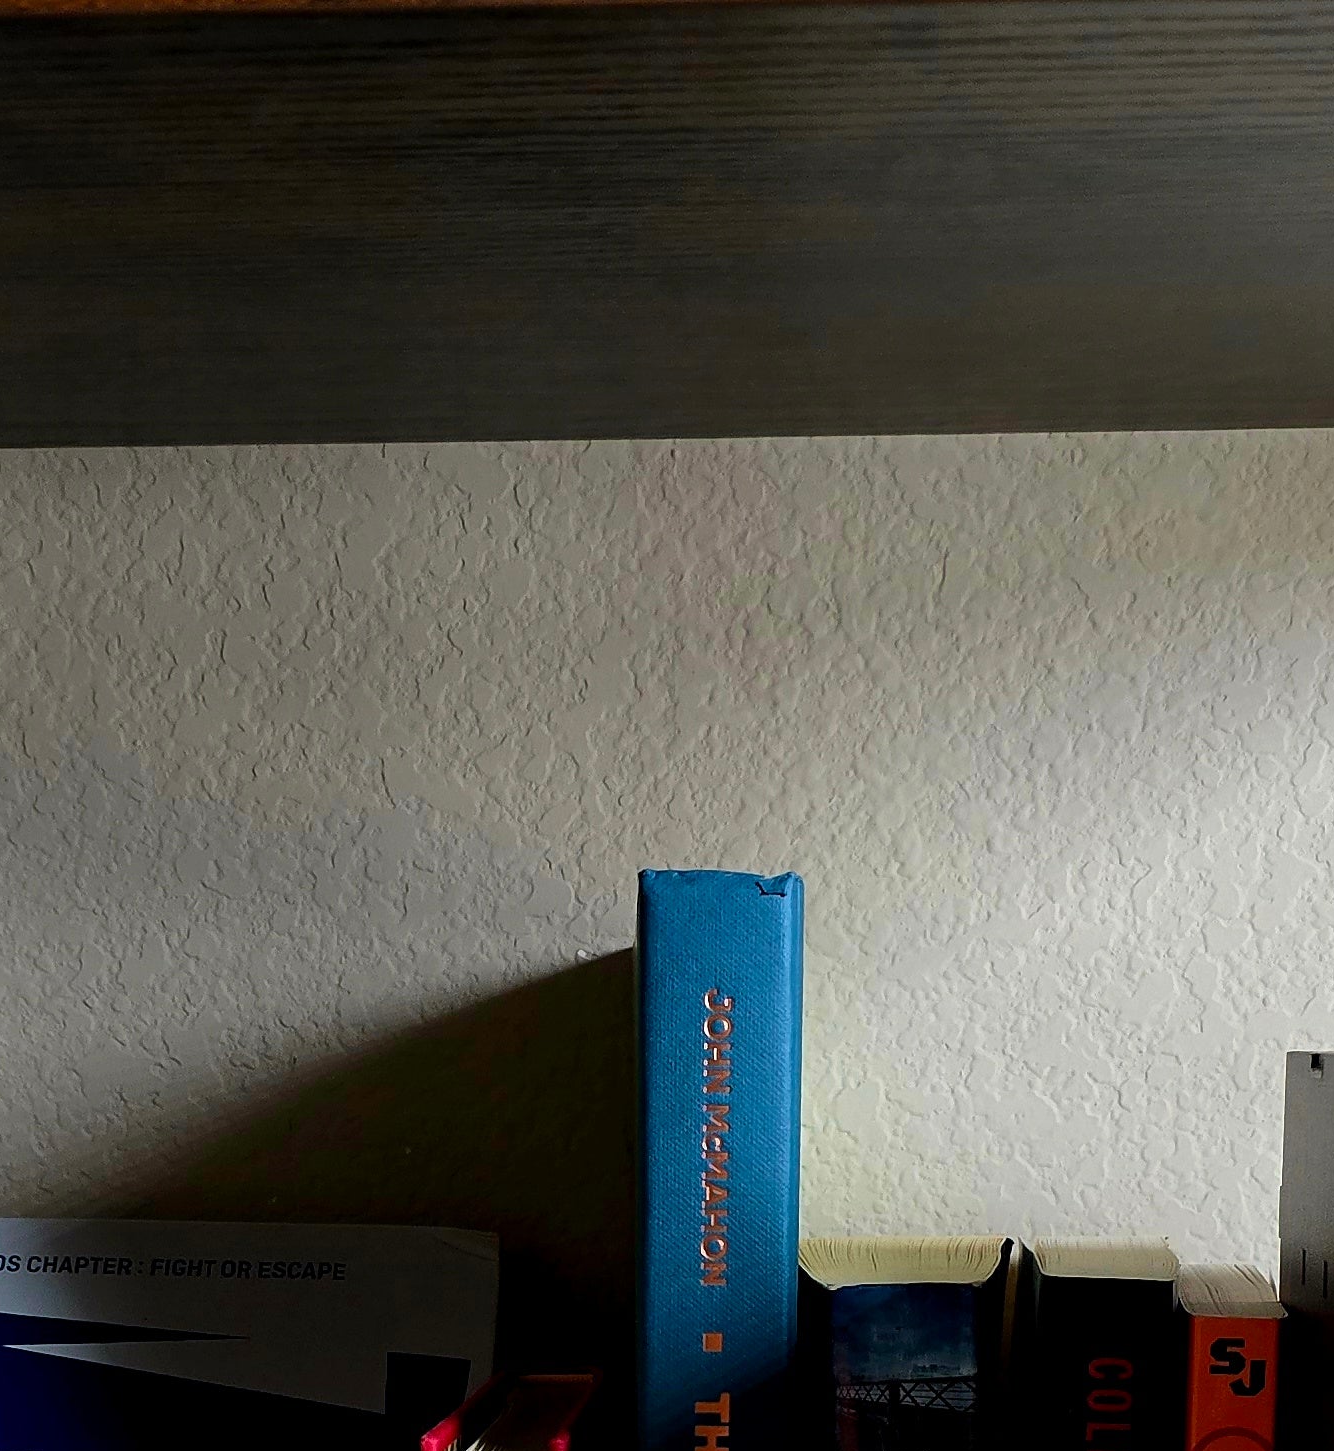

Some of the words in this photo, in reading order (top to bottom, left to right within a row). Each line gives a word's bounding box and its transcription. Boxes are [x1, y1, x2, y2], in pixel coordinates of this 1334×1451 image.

[702, 989, 734, 1092] JOHN
[700, 1105, 732, 1288] McMAHON
[26, 1256, 133, 1276] CHAPTER
[150, 1258, 217, 1278] FIGHT
[221, 1260, 253, 1279] OR
[258, 1260, 347, 1281] ESCAPE
[1209, 1337, 1266, 1398] SJ
